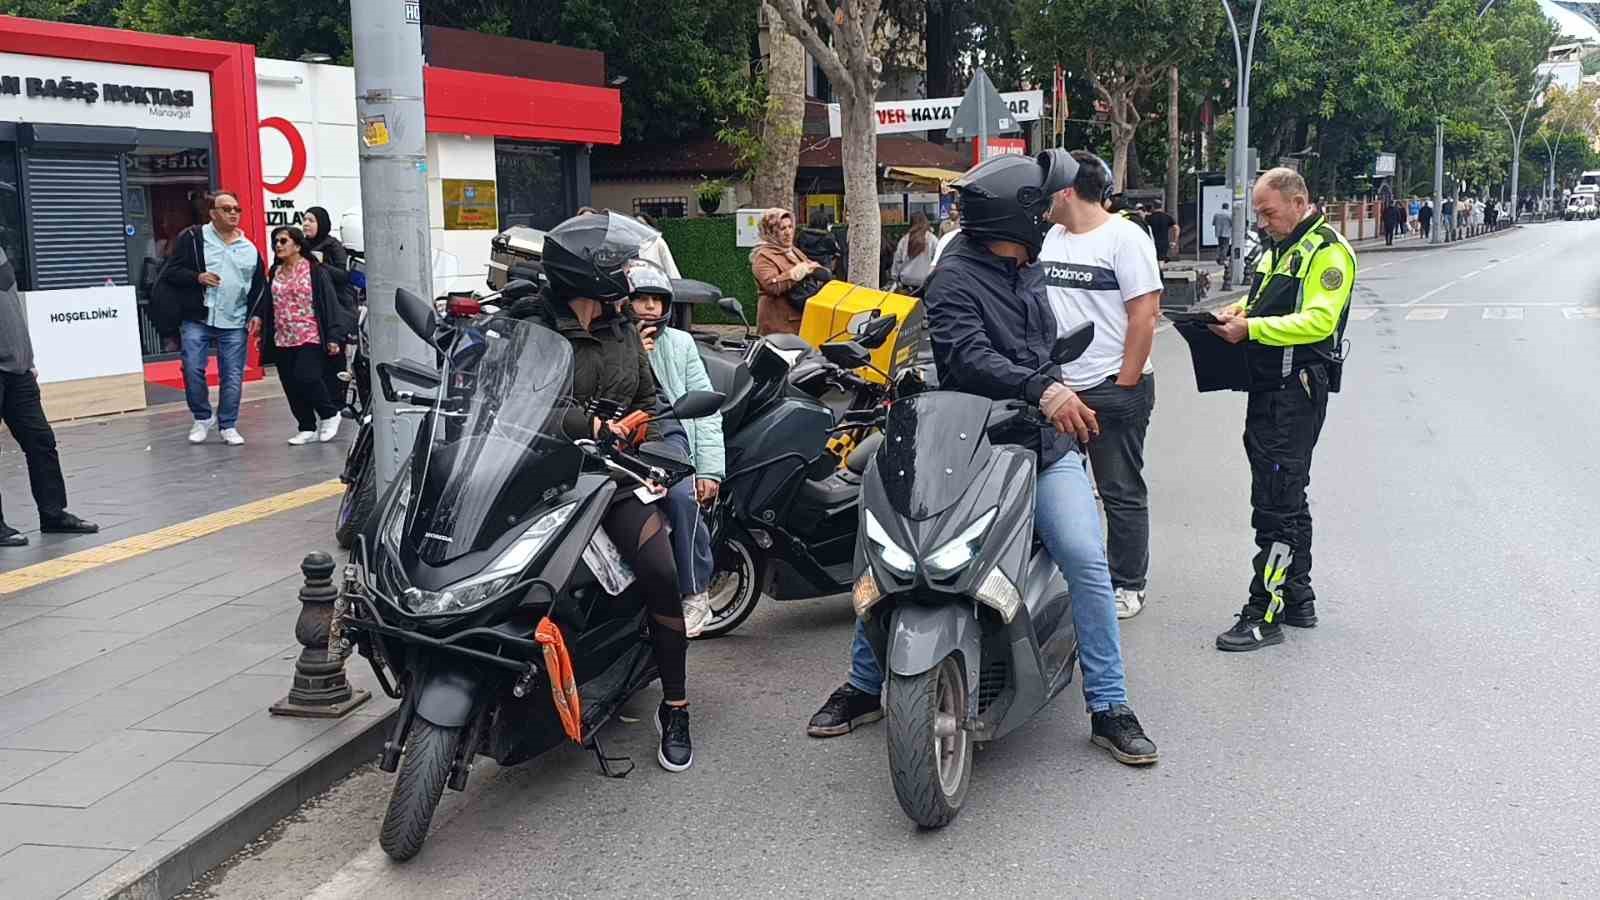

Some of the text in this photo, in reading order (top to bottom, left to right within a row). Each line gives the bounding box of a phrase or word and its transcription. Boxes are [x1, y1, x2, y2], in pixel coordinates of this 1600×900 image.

[102, 83, 194, 107] NOKTASI
[150, 107, 191, 119] Manavgat
[876, 109, 907, 125] VER
[270, 196, 295, 209] TÜRK
[1051, 266, 1093, 282] balance
[50, 307, 118, 324] HOŞGELDİNİZ
